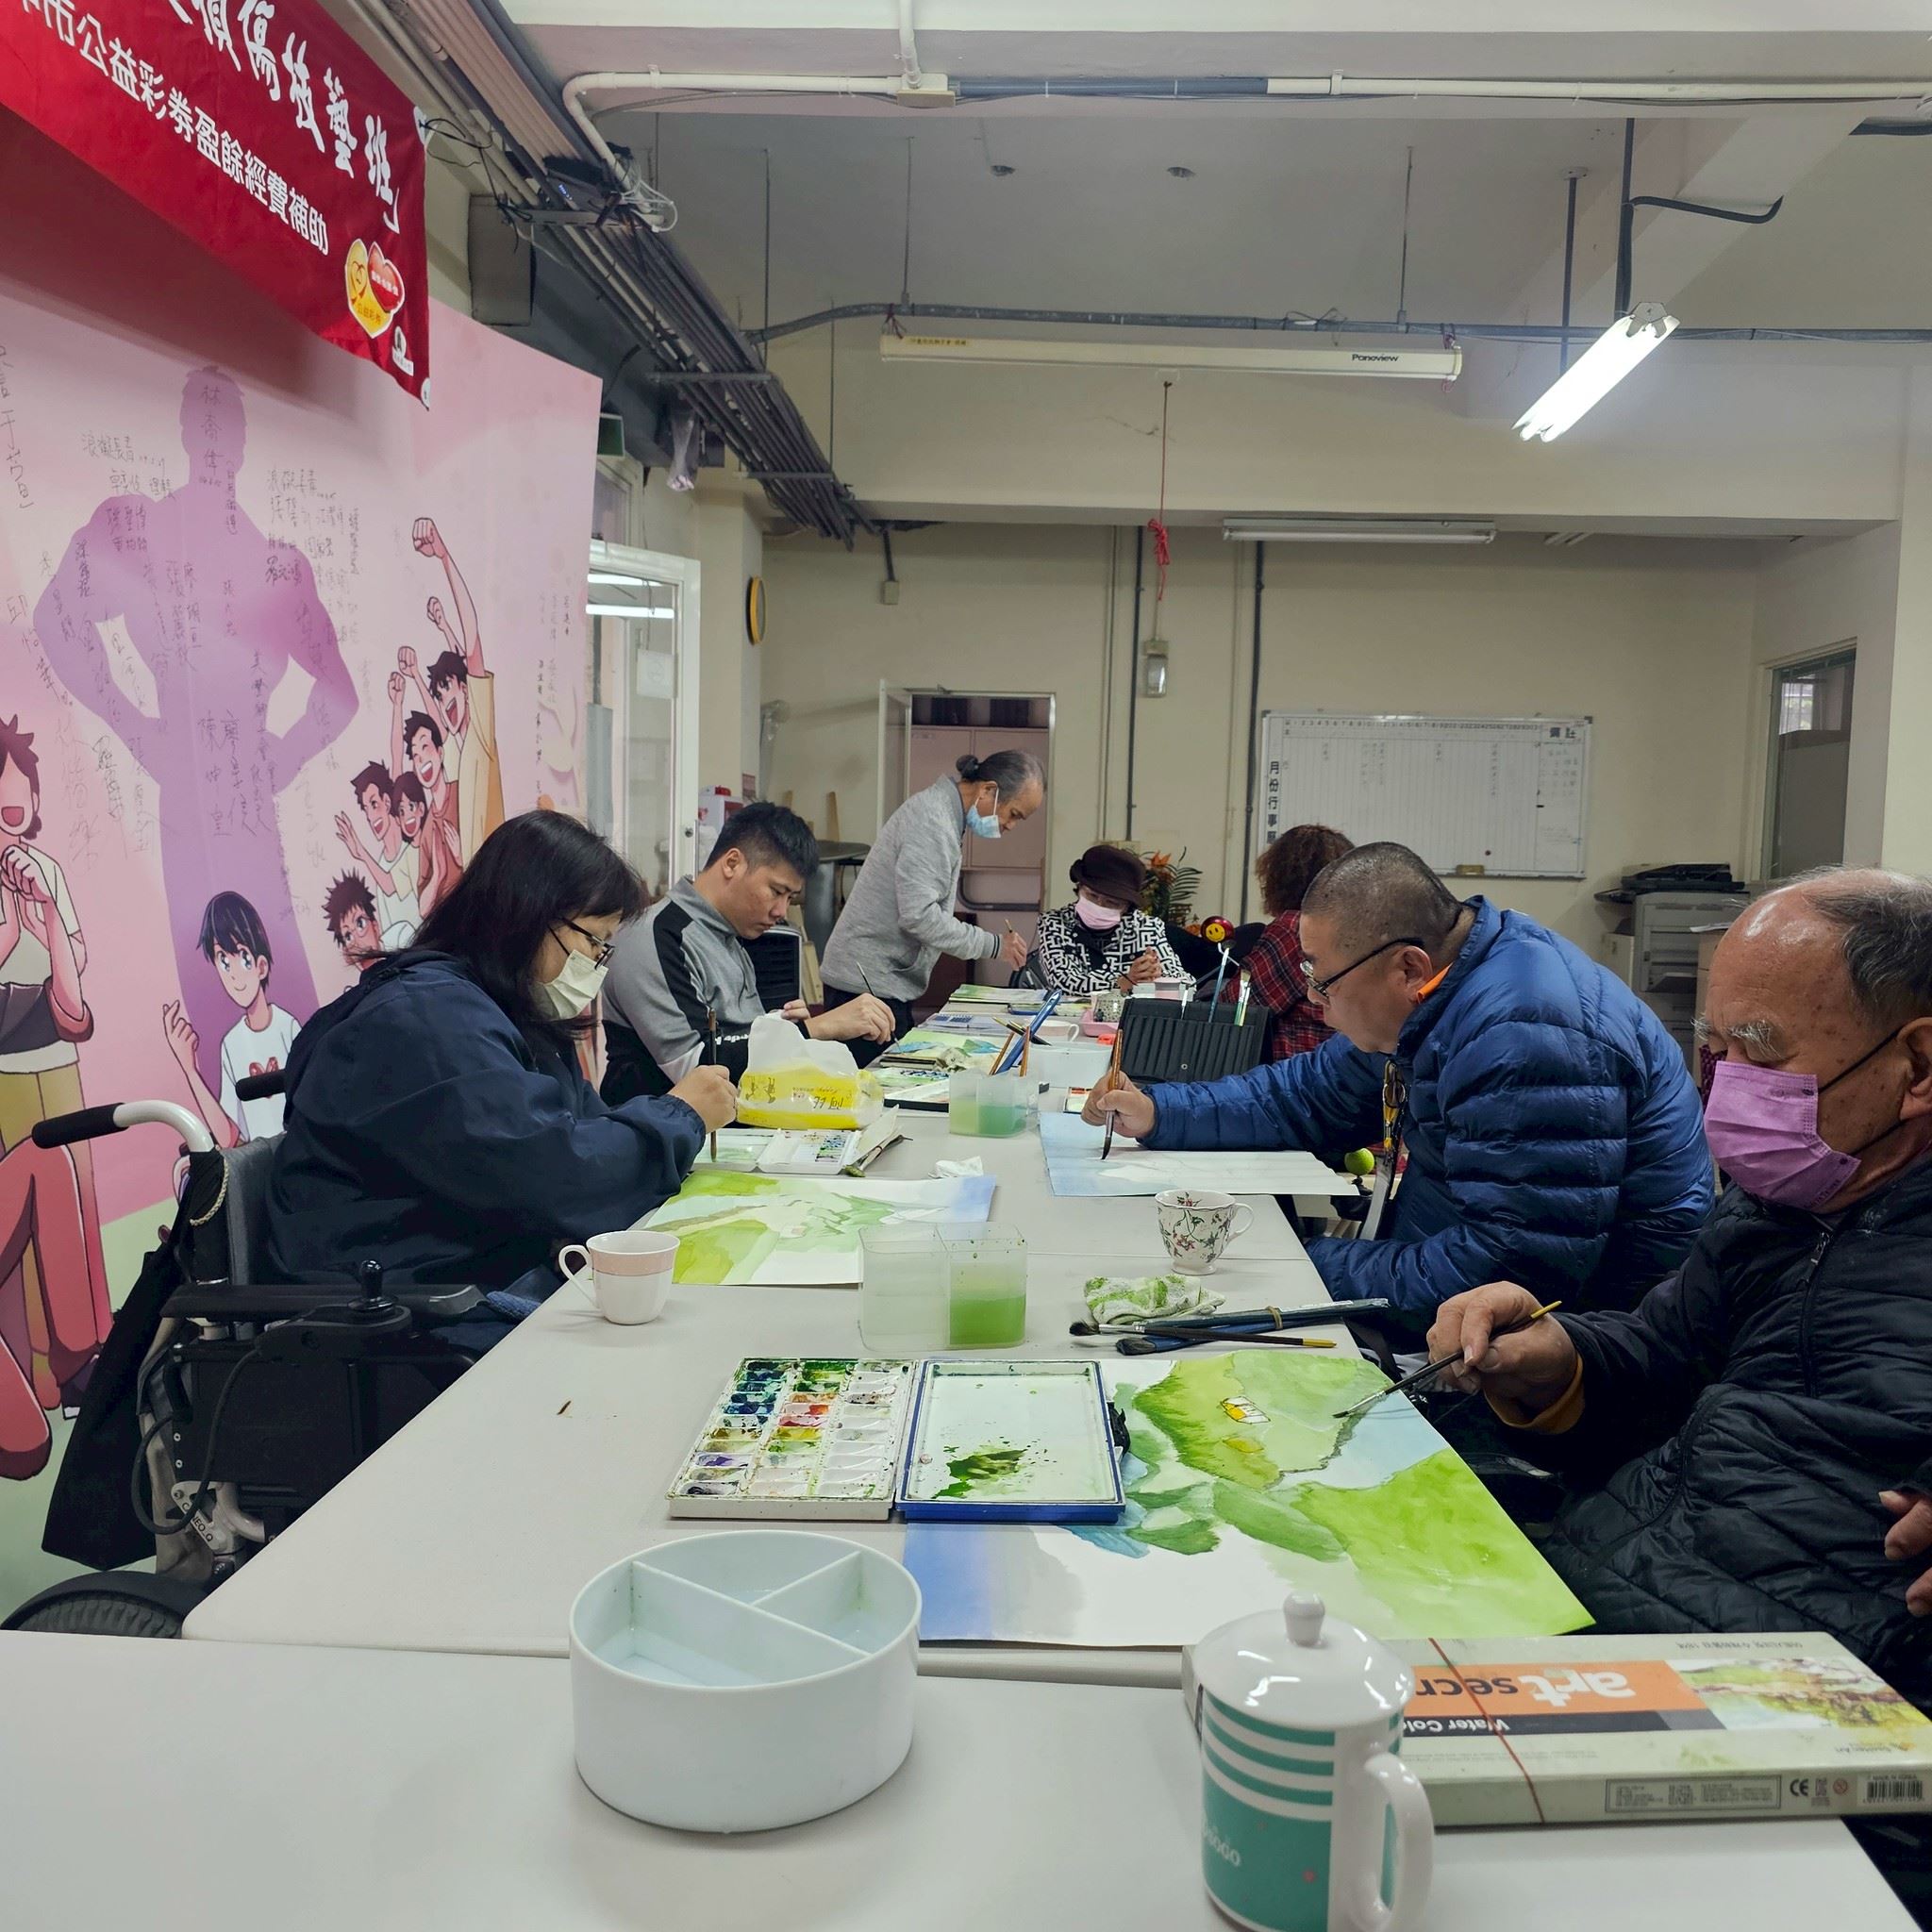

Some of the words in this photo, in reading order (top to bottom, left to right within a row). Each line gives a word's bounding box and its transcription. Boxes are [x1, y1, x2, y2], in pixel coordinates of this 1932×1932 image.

[23, 0, 329, 256] 市公益彩券盈餘經費補助
[1518, 1668, 1637, 1707] art
[1403, 1720, 1443, 1733] Col
[1448, 1718, 1510, 1732] Water
